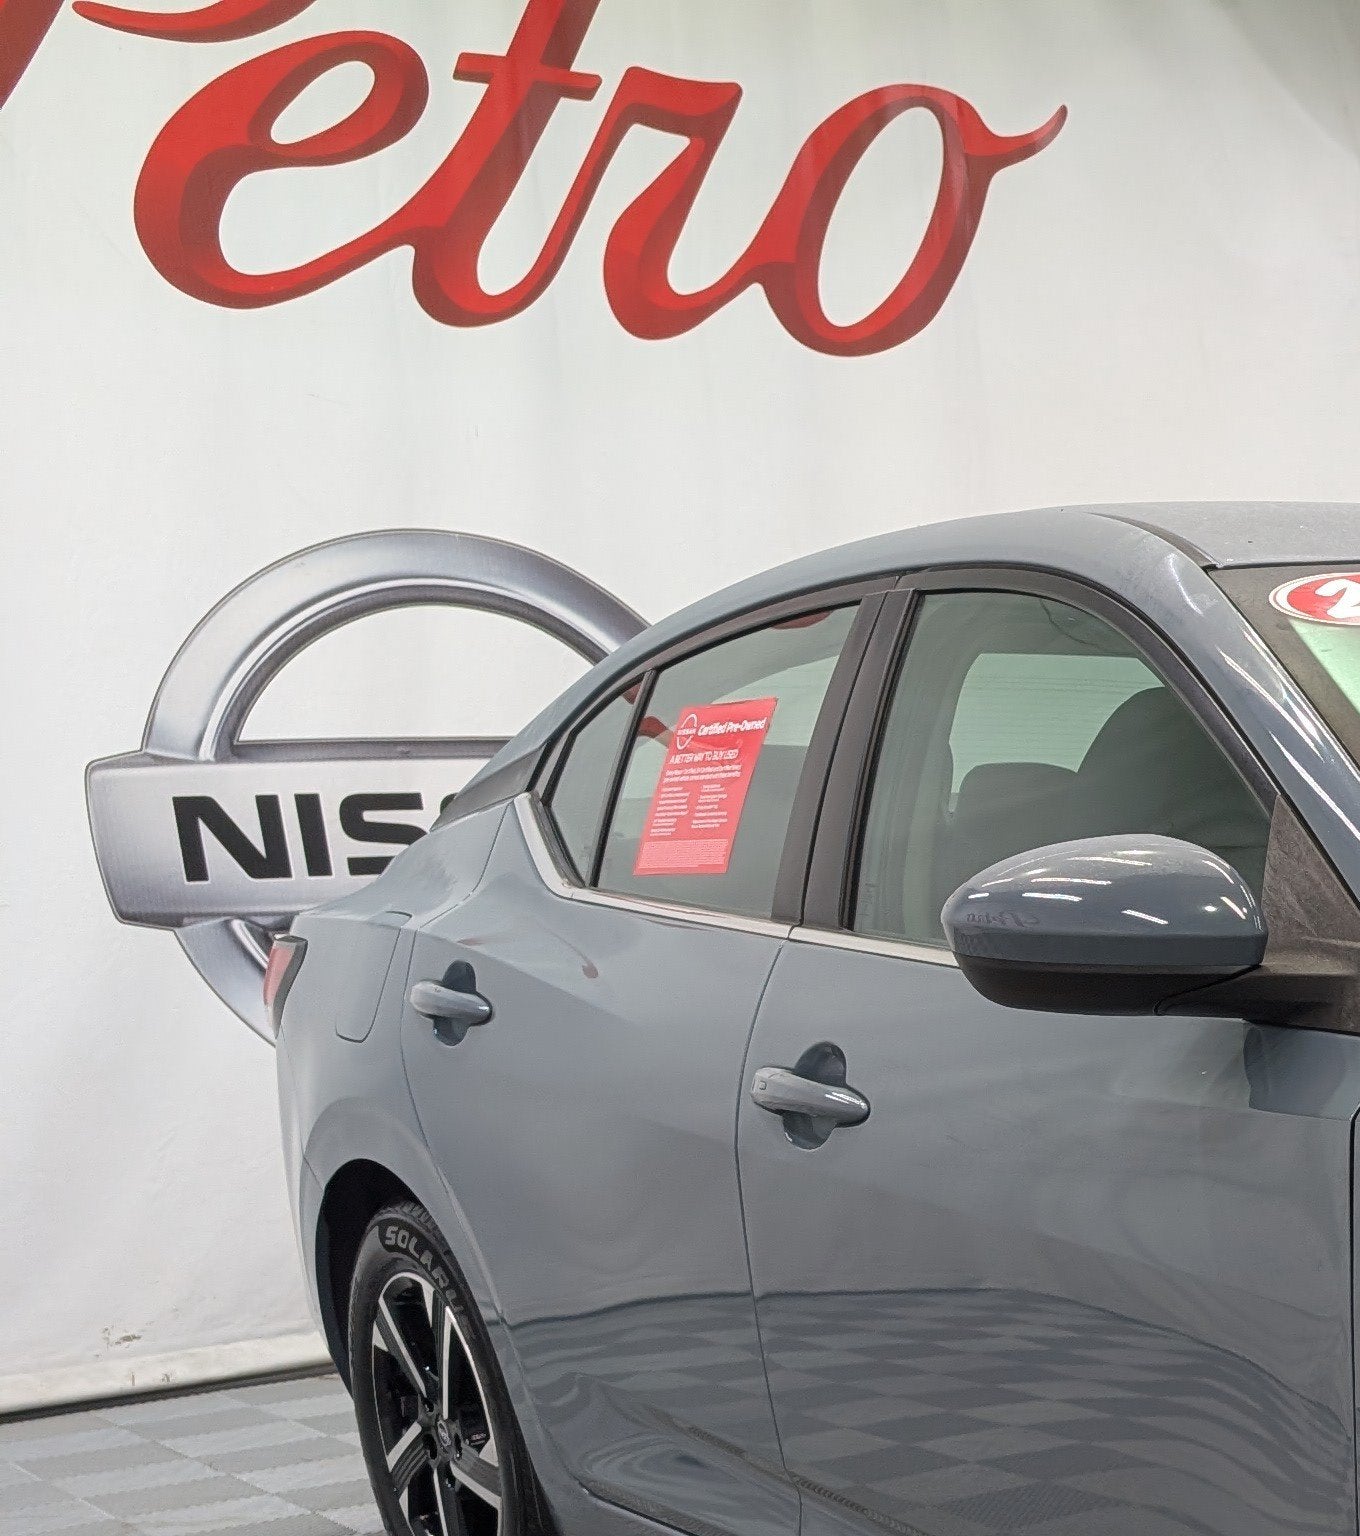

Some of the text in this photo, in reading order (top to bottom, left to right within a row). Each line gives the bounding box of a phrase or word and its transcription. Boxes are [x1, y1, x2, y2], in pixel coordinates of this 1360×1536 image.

[0, 0, 1067, 357] etro
[698, 717, 767, 736] Certified Pre-Owned
[172, 792, 459, 883] NIS
